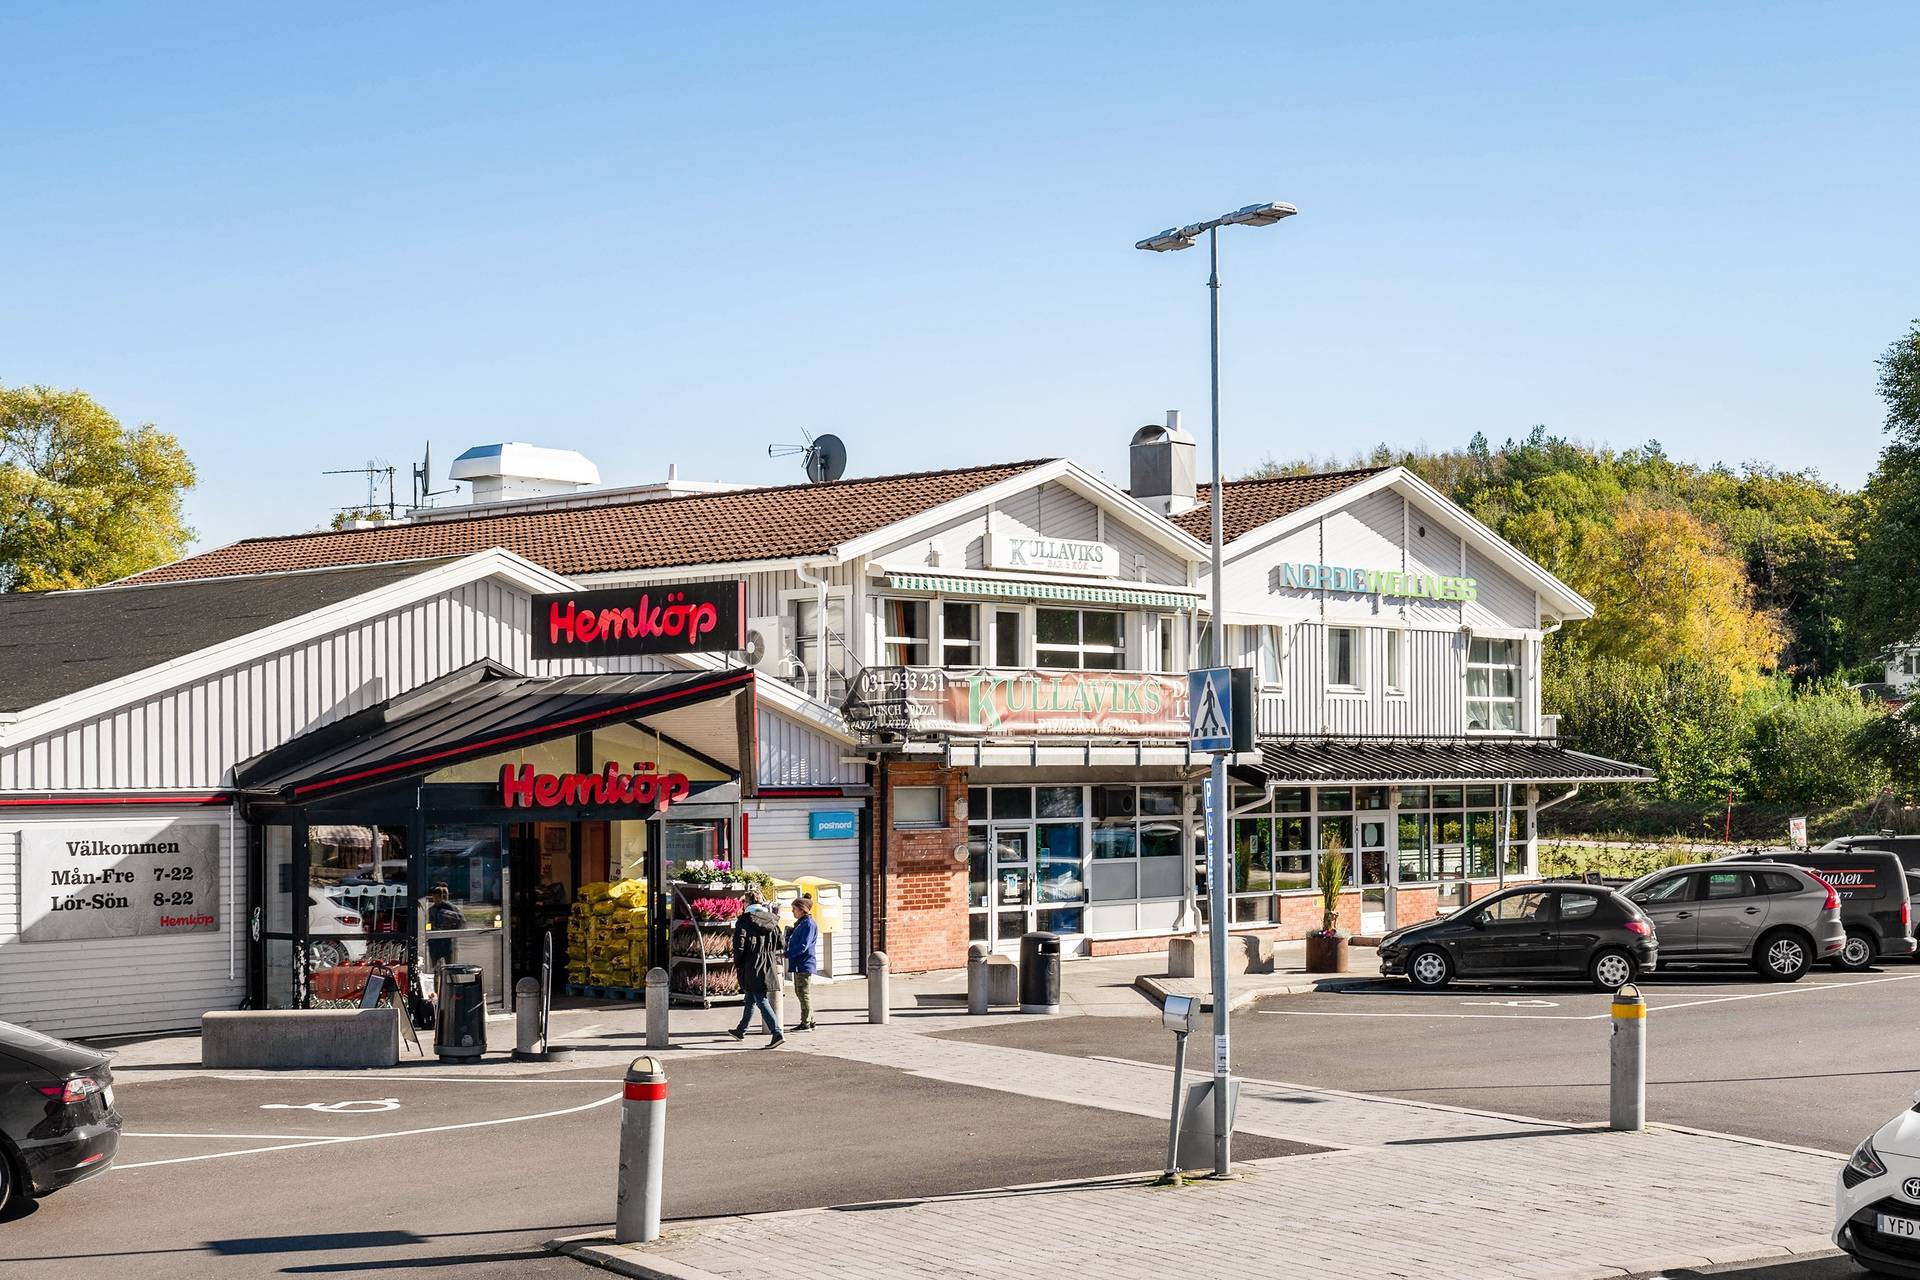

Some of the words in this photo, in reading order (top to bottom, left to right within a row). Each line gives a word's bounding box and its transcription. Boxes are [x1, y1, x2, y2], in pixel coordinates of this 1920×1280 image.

[1009, 538, 1104, 566] KULLAVIKS
[549, 591, 717, 645] Hemköp
[920, 673, 945, 692] 231
[965, 675, 1161, 731] KULLAVIKS
[501, 761, 690, 812] Hemköp
[818, 820, 852, 831] postnord
[66, 840, 180, 857] Välkommen
[51, 867, 135, 886] Mån-Fre
[153, 866, 194, 882] 7-22
[51, 893, 129, 912] Lör-Sön
[153, 891, 194, 907] 8-22
[160, 913, 214, 928] Hemköp
[1889, 1217, 1914, 1236] YFD
